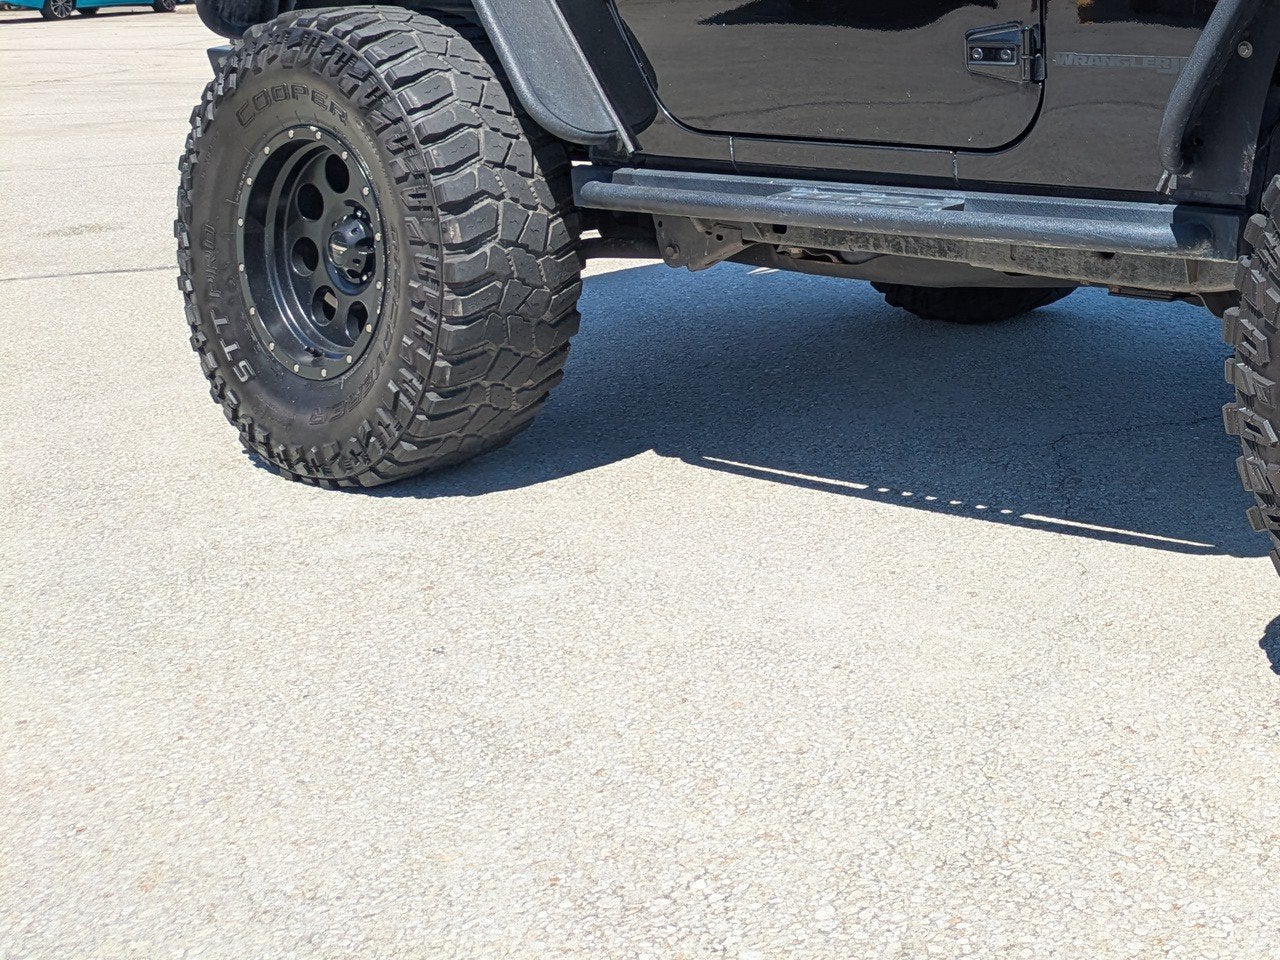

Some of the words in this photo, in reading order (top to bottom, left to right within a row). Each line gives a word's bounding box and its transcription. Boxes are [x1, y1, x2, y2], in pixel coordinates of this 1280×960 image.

[1055, 53, 1170, 68] WRANGLER
[236, 82, 348, 128] COOPER
[198, 222, 227, 303] PRO
[214, 310, 256, 384] STT
